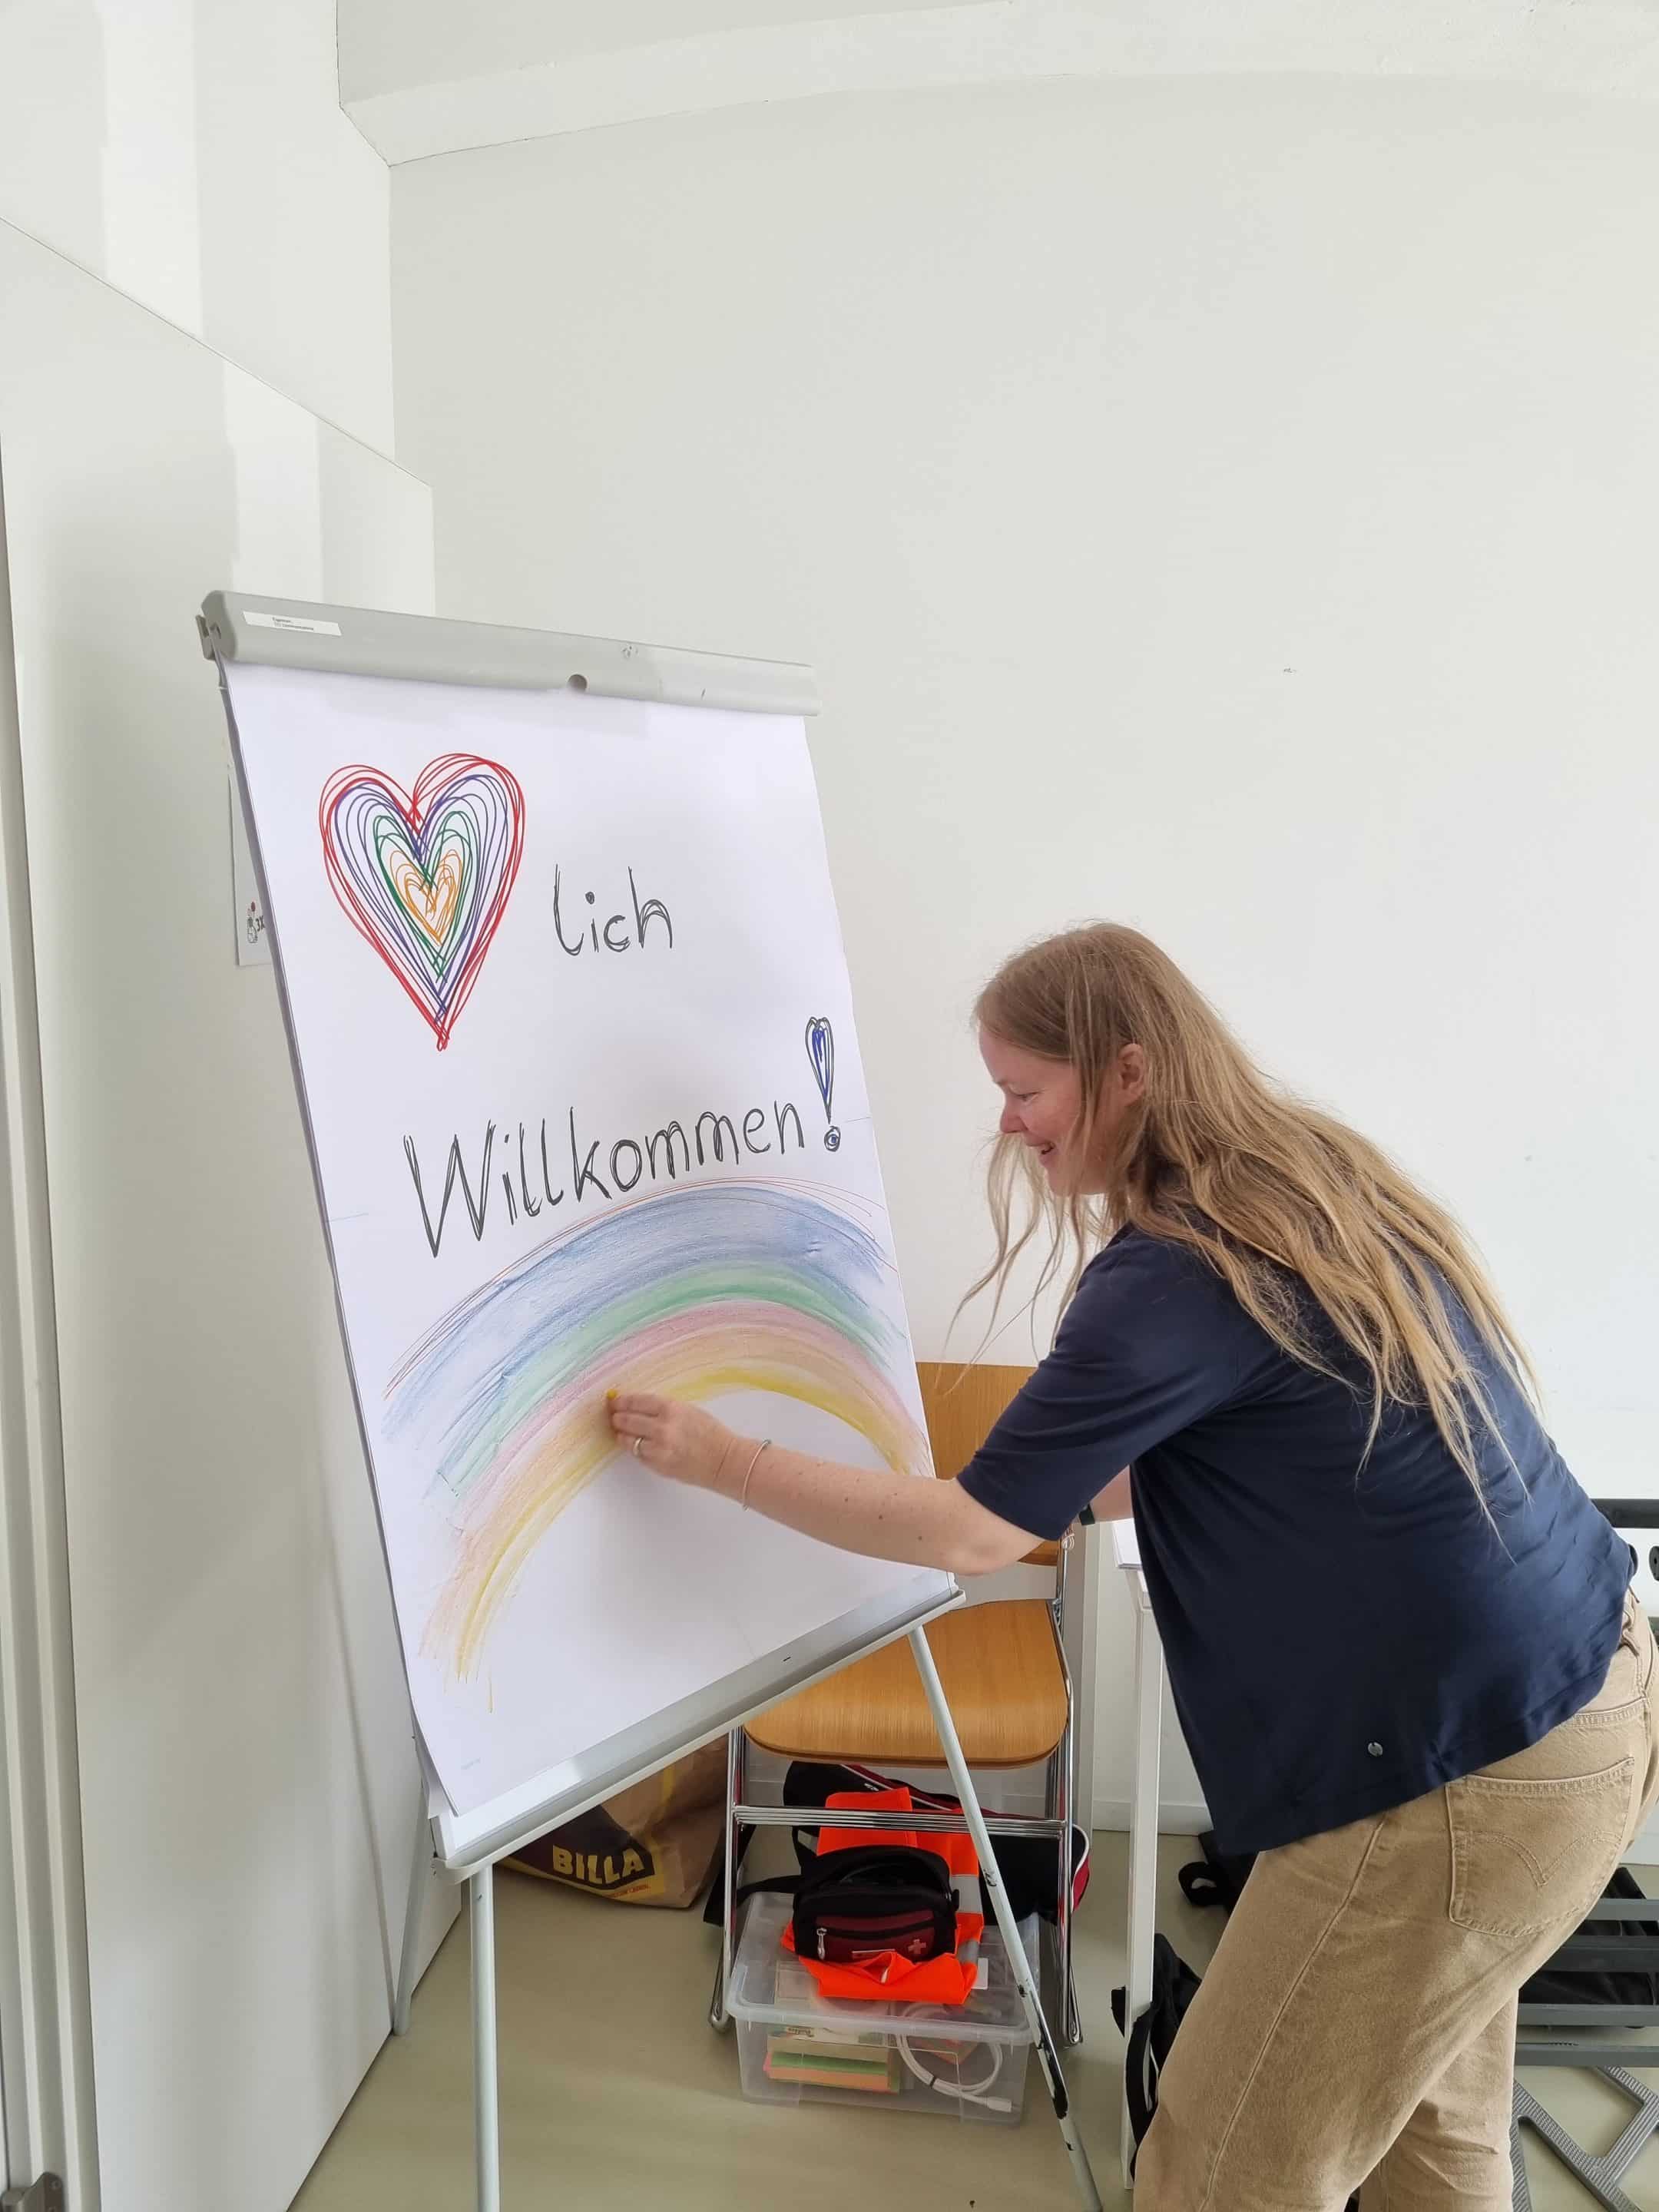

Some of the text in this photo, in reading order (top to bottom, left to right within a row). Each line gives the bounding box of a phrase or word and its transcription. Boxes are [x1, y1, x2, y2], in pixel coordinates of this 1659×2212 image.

[554, 864, 673, 956] lich
[403, 1016, 841, 1258] Willkommen!
[552, 1845, 645, 1884] BILLA
